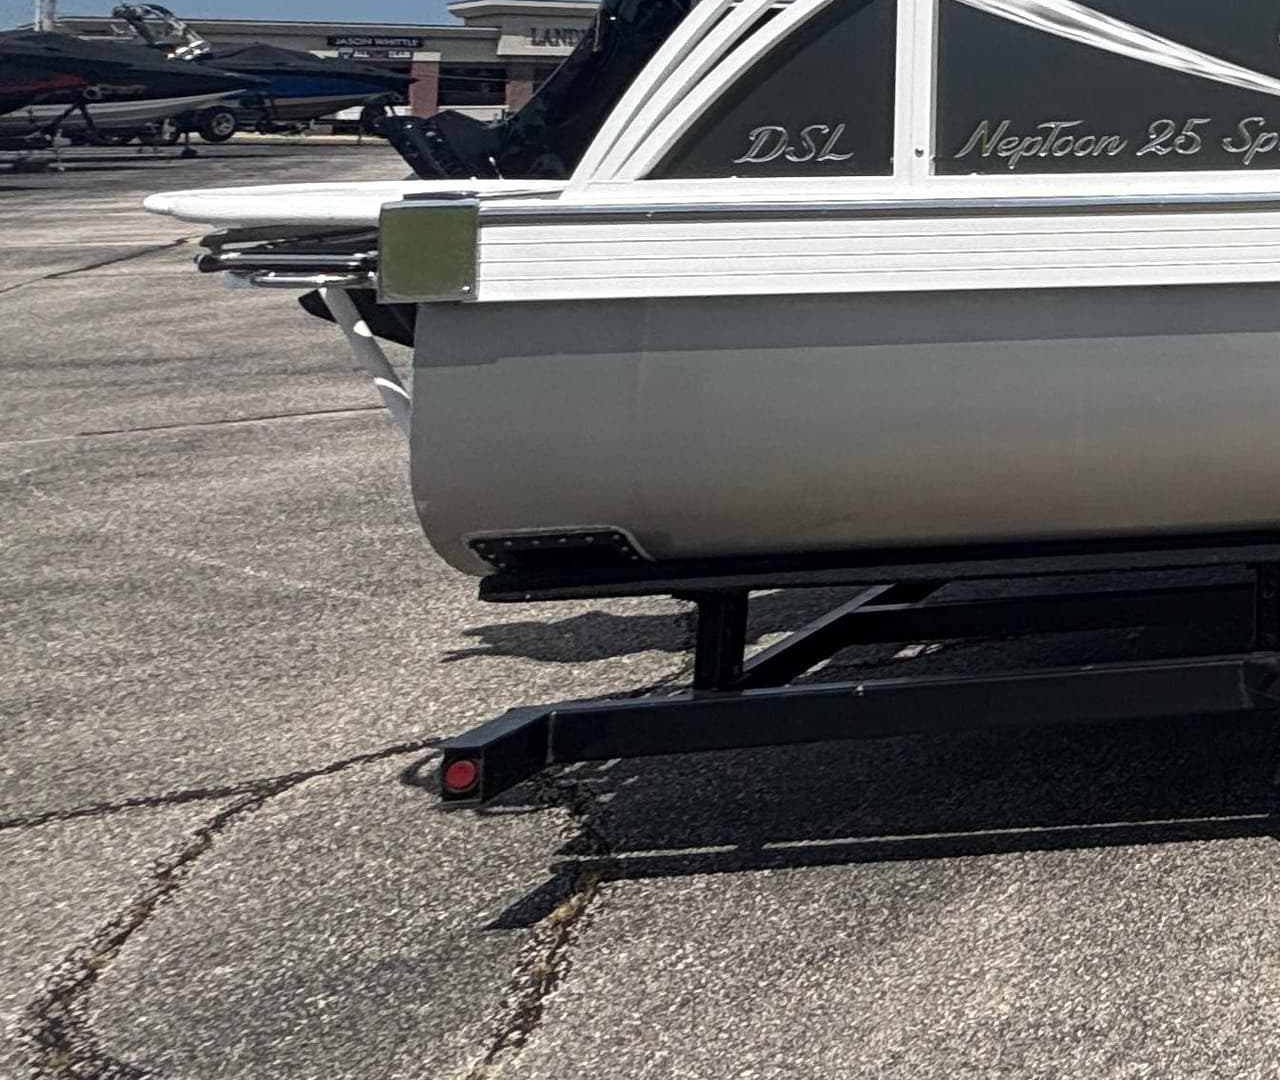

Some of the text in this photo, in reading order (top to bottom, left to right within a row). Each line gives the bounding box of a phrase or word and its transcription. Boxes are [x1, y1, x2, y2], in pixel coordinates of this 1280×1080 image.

[733, 123, 855, 163] DSL
[954, 119, 1129, 170] NepToon
[1136, 118, 1211, 157] 25
